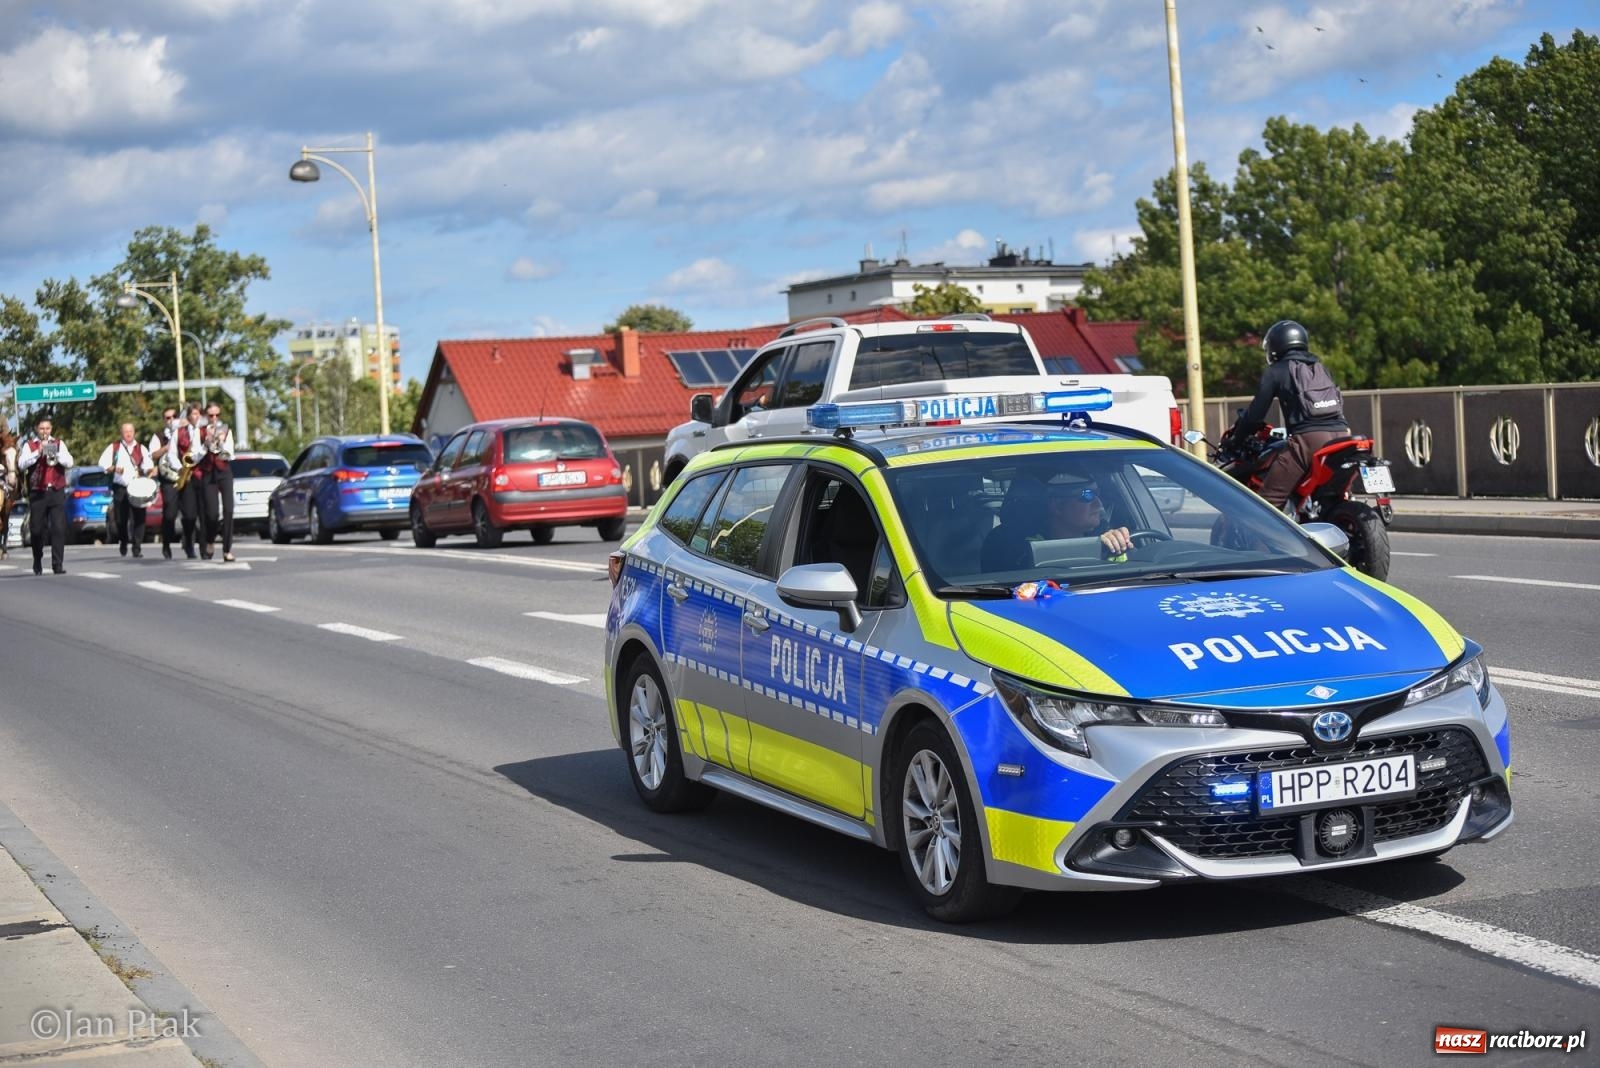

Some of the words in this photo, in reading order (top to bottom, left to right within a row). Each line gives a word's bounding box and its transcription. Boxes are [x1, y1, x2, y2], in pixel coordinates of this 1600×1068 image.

[43, 387, 73, 400] Rybnik
[920, 396, 996, 420] POLICJA
[1168, 626, 1388, 671] POLICJA
[770, 634, 847, 704] POLICJA
[1279, 770, 1331, 804] HPP
[1343, 759, 1409, 796] R204
[1261, 794, 1272, 804] PL
